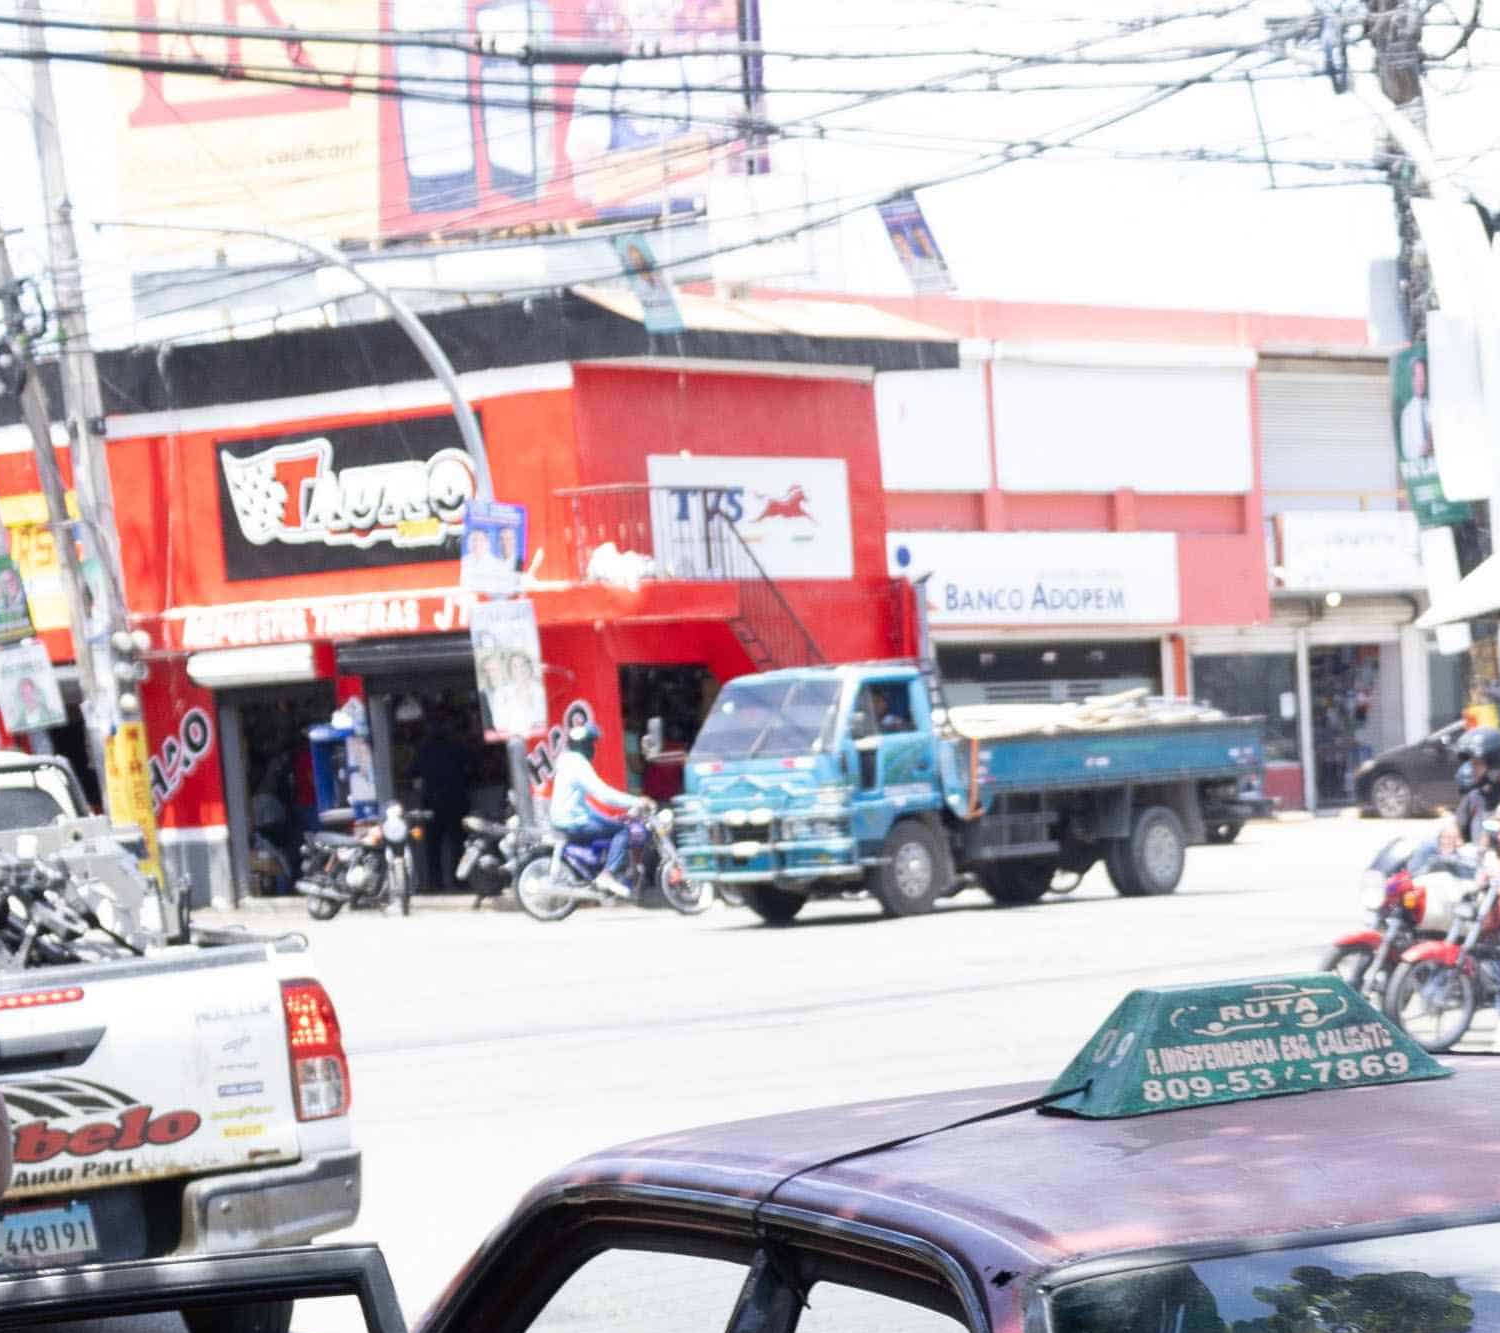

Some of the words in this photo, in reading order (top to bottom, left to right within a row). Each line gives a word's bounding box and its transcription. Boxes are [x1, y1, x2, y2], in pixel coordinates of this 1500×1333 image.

[944, 583, 1024, 611] BANCO
[1030, 582, 1125, 611] ADOPEM
[1219, 998, 1319, 1022] RUTA
[14, 1167, 74, 1188] Auto
